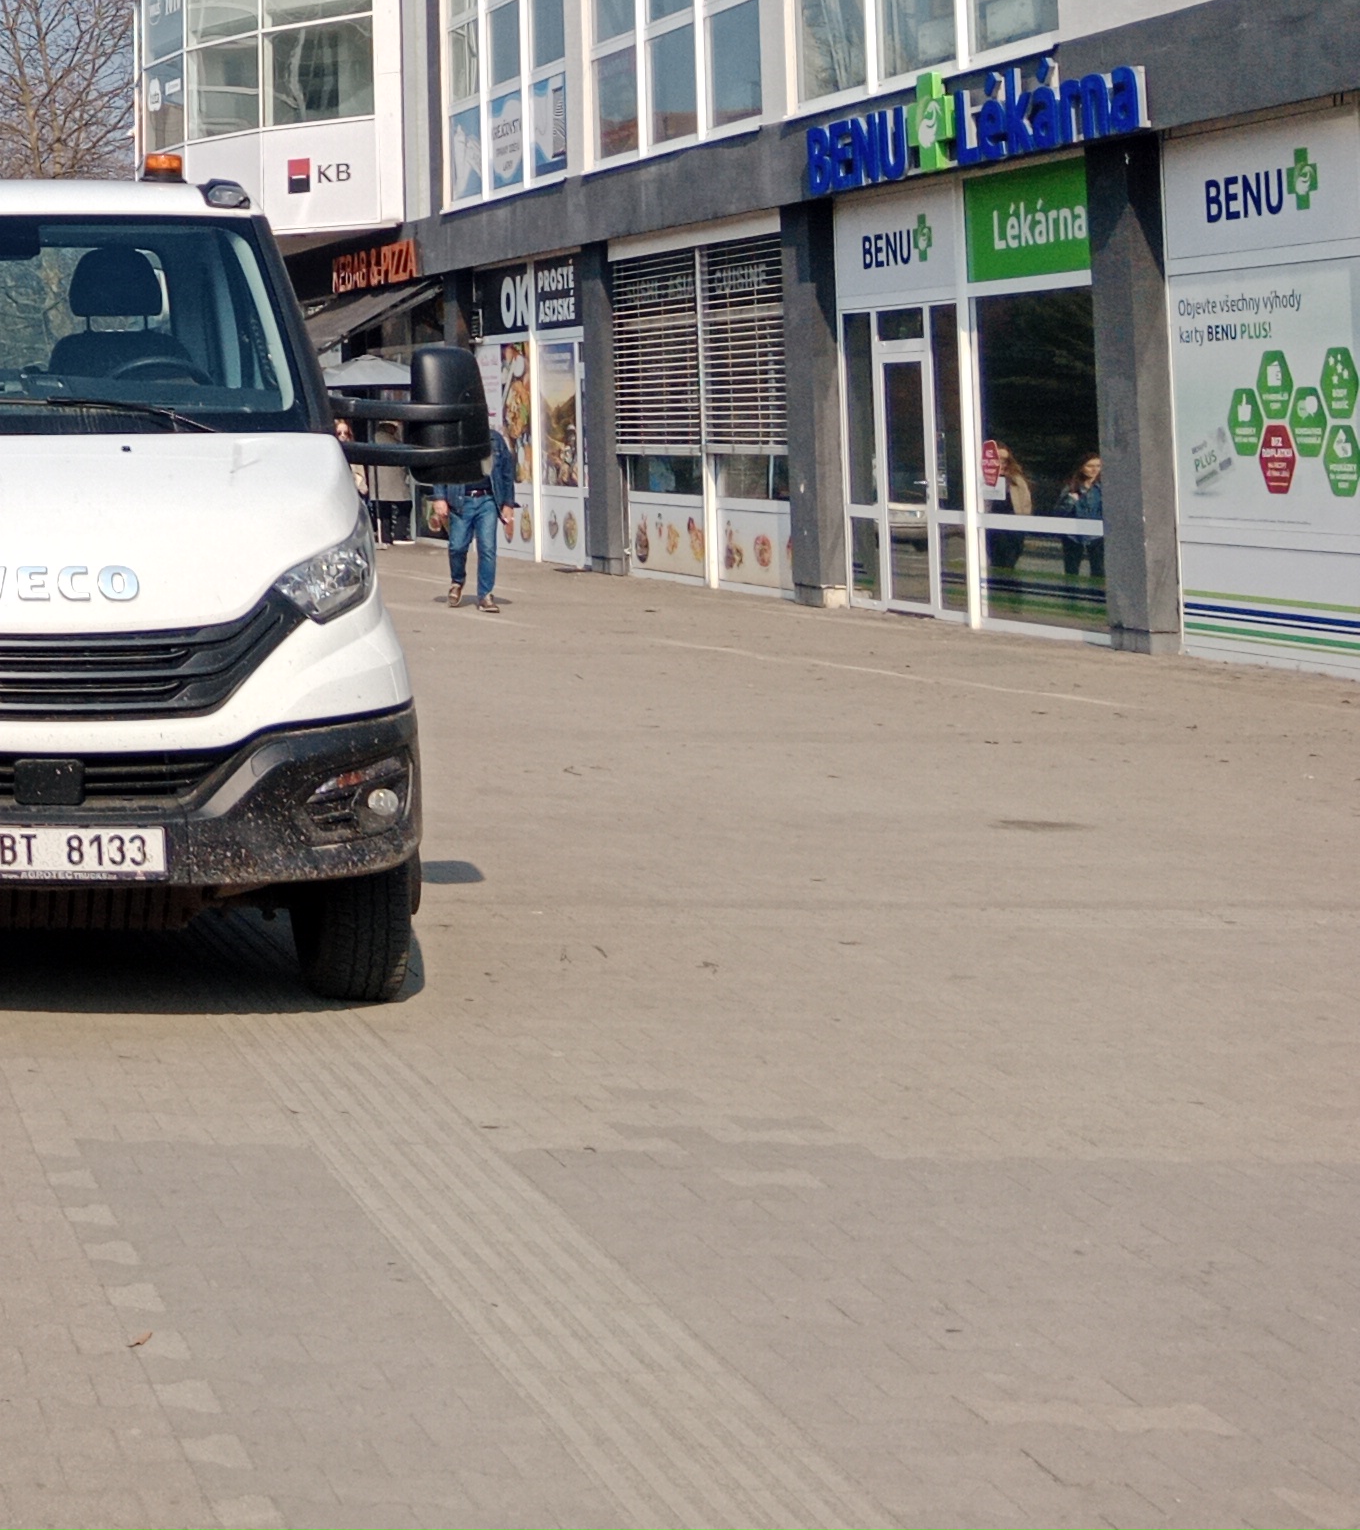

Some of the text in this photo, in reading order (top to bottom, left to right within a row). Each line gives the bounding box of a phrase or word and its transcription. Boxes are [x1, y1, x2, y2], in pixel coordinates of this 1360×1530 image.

[806, 57, 1150, 196] BENU Lékárna
[316, 163, 351, 184] KB
[1205, 168, 1284, 223] BENU
[992, 198, 1087, 250] Lékárna
[332, 251, 367, 294] KEBAB
[380, 238, 417, 285] PIZZA
[862, 229, 912, 270] BENU
[1178, 288, 1301, 319] Objevte všechny výhody
[1179, 322, 1272, 346] karty BENU PLUS!
[66, 834, 147, 867] 8133
